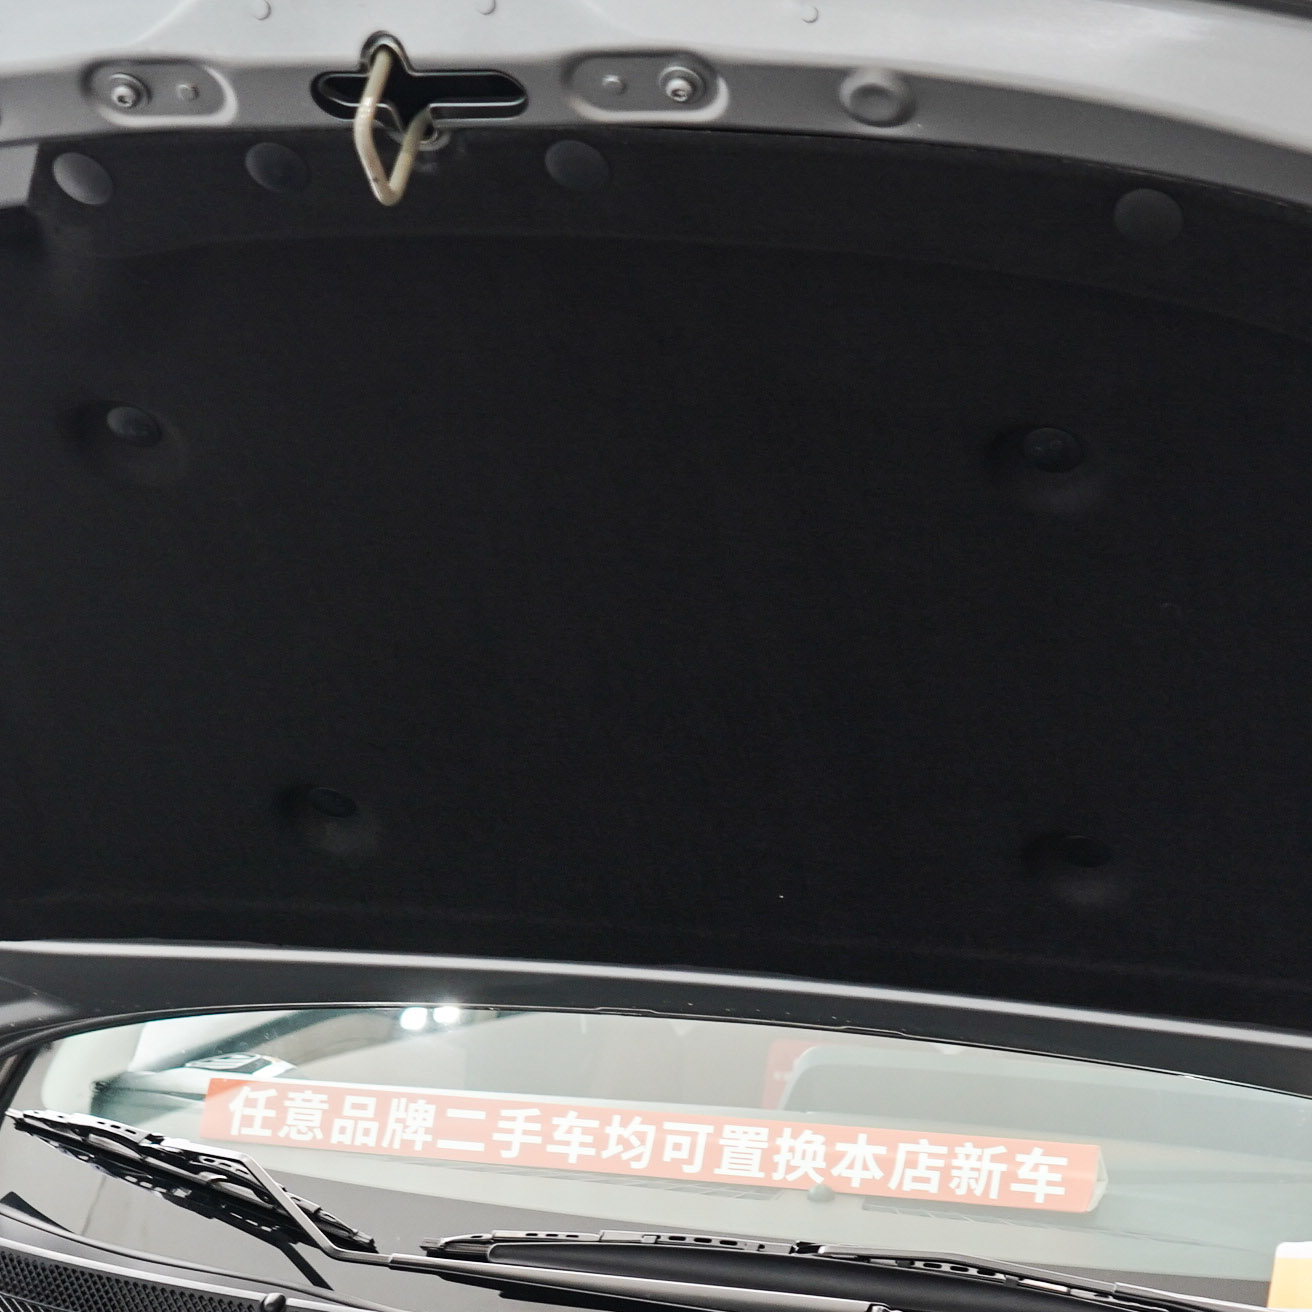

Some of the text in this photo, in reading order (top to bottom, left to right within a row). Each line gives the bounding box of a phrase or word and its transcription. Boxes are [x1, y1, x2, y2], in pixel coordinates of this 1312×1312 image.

[228, 1085, 1069, 1204] 任意品牌二手车均可置换本店新车
